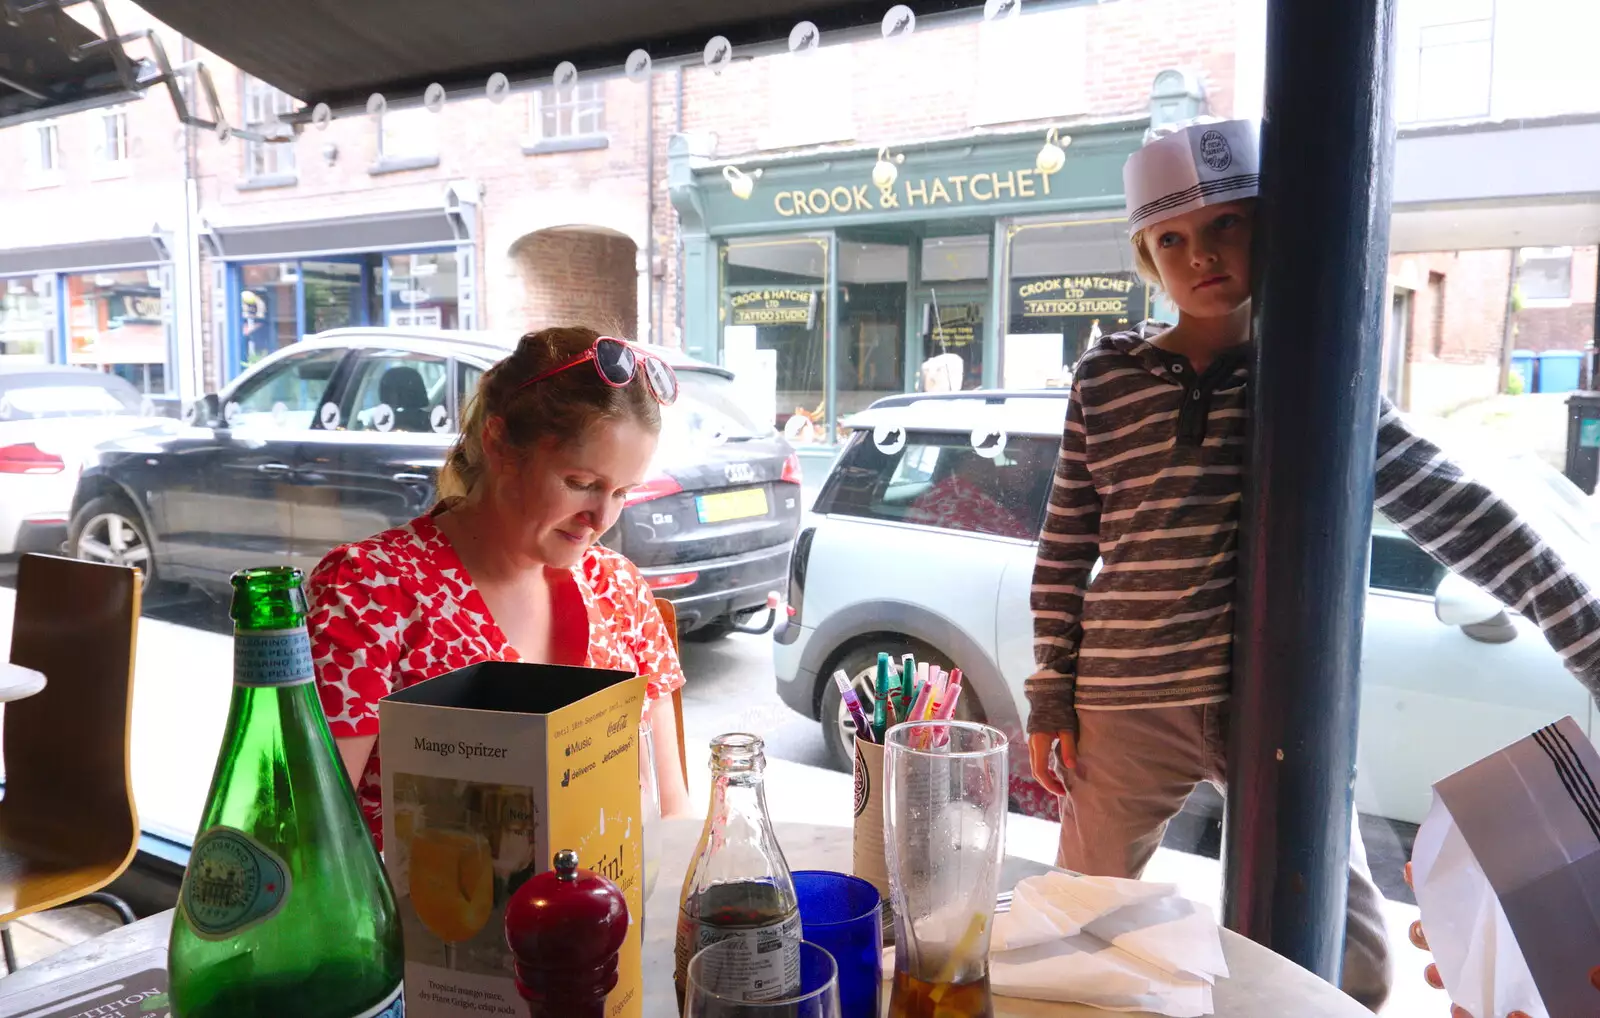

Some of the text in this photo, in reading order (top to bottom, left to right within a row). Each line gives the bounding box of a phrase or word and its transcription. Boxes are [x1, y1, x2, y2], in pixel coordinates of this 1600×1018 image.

[774, 184, 873, 216] CROOK
[905, 168, 1052, 206] HATCHET
[1019, 277, 1134, 297] CROOK & HATCHET
[1065, 289, 1084, 298] LTD
[731, 291, 762, 307] CROOK
[1030, 300, 1122, 313] TATTOO STUDIO
[739, 310, 807, 321] TATTOO STUDIO
[414, 737, 508, 758] Mango Spritzer
[571, 737, 592, 754] Music
[429, 981, 456, 993] Tropical
[458, 988, 482, 997] mango
[497, 1006, 515, 1014] soda
